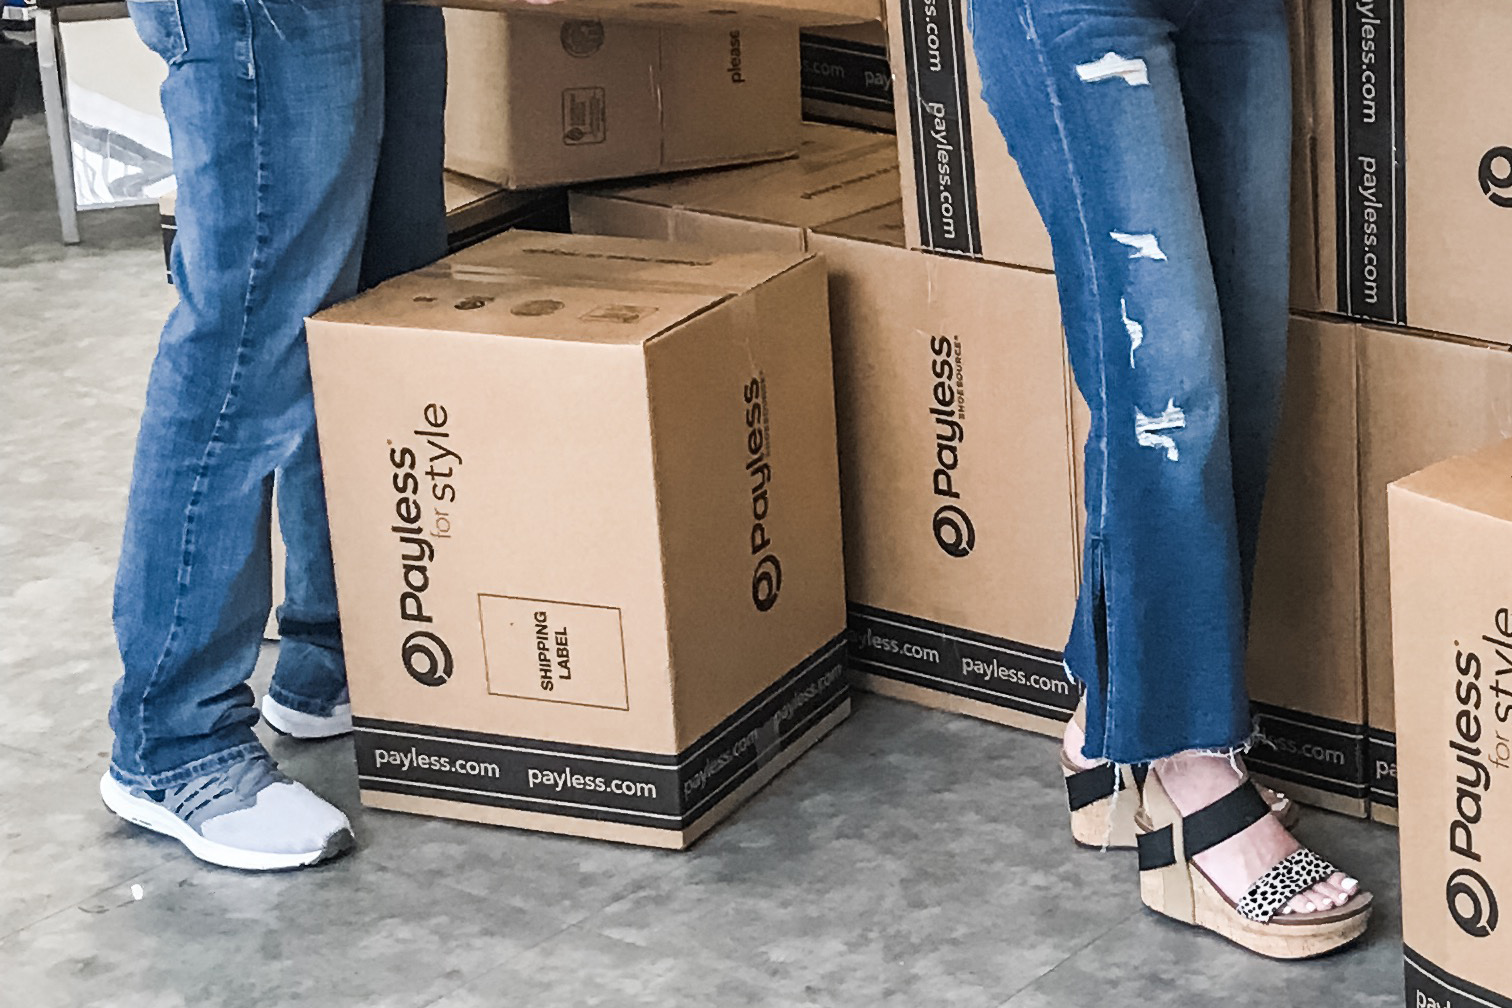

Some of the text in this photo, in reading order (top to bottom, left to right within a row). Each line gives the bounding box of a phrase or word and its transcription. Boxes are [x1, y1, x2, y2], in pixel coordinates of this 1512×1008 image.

[730, 29, 746, 84] please
[928, 102, 955, 239] payless.com
[1356, 155, 1382, 304] payless.com
[413, 402, 462, 539] for style
[744, 376, 771, 555] Payless
[928, 335, 964, 500] Payless
[390, 447, 434, 623] Payless
[534, 611, 554, 692] SHIPPING
[554, 626, 572, 681] LABEL
[962, 657, 1069, 695] payless.com
[374, 747, 658, 799] payless.com payless.com
[1449, 652, 1491, 864] Payless
[1488, 732, 1511, 770] for
